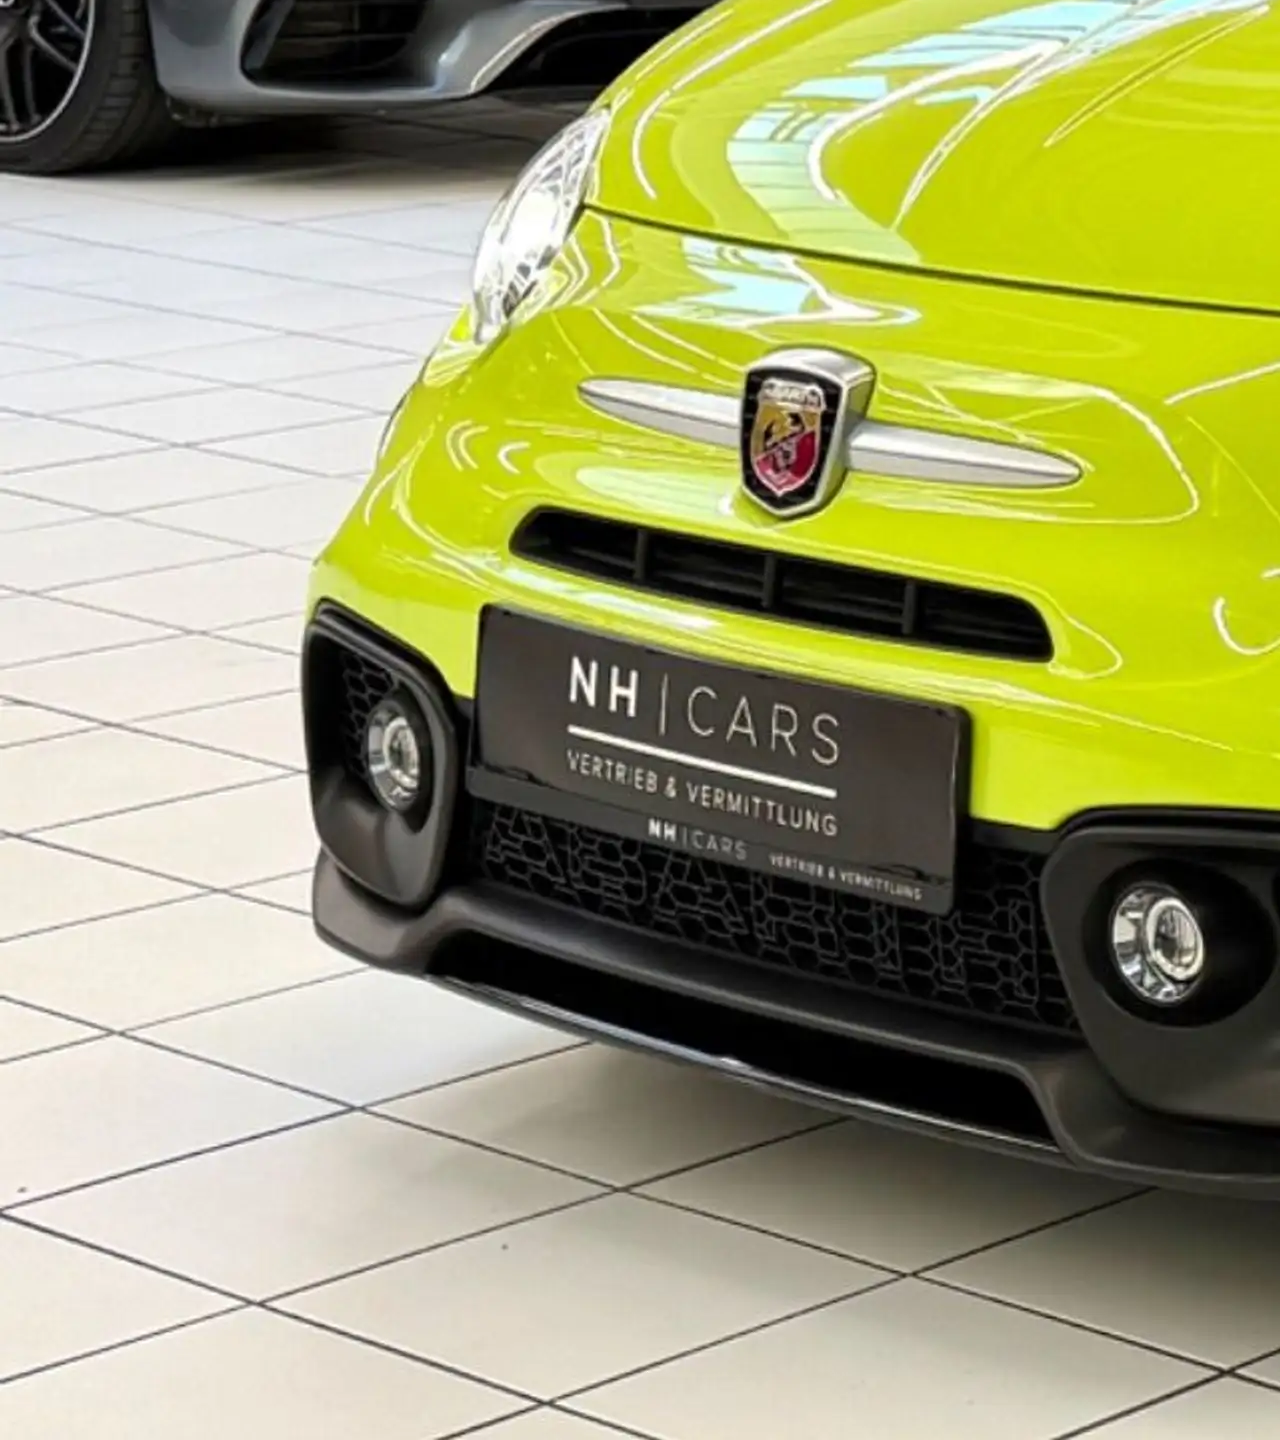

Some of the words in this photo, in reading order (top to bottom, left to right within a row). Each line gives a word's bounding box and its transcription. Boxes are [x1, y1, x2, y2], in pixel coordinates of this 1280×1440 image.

[568, 655, 639, 718] NH
[686, 685, 842, 766] CARS
[566, 749, 658, 794] VERTRIEB
[663, 776, 678, 799] &
[686, 781, 839, 837] VERMITTLUNG
[647, 817, 677, 841] NH
[692, 828, 748, 861] CARS
